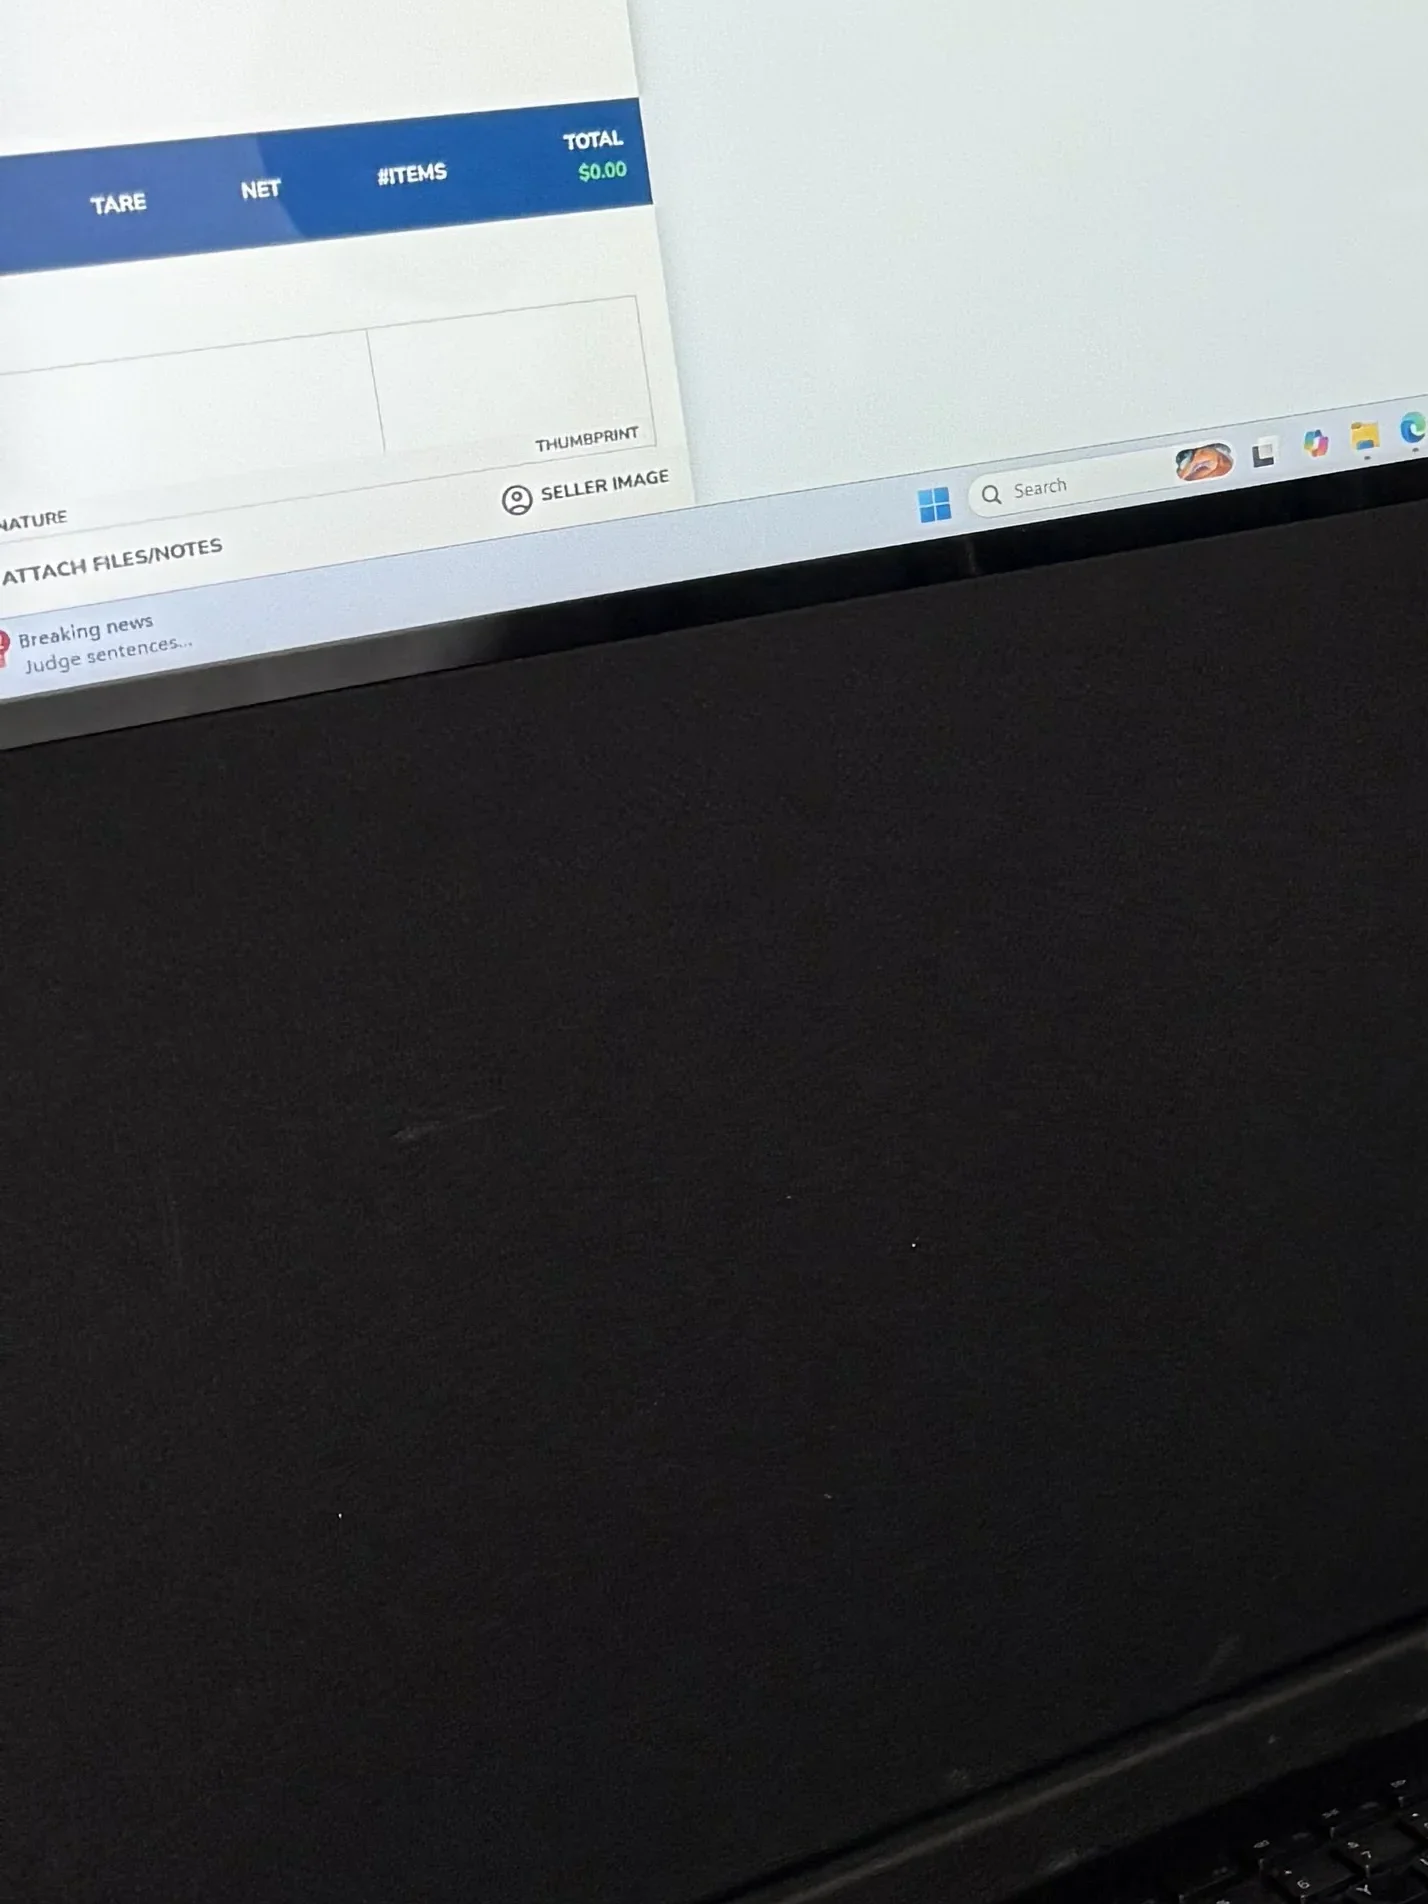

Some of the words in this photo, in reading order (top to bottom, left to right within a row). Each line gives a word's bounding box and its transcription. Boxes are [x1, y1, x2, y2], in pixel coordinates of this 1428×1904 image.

[91, 193, 148, 215] TARE
[241, 179, 282, 200] NET
[377, 162, 448, 187] #ITEMS
[563, 130, 624, 152] TOTAL
[578, 162, 628, 183] $0.00
[535, 425, 640, 454] THUMBPRINT
[541, 478, 608, 503] SELLER
[612, 468, 670, 493] IMAGE
[1013, 474, 1068, 499] Search
[1, 558, 88, 587] ATTACH
[92, 537, 224, 572] FILES/NOTES
[18, 620, 102, 651] Breaking
[106, 614, 154, 635] news
[25, 650, 82, 677] Judge
[86, 636, 193, 666] sentences...
